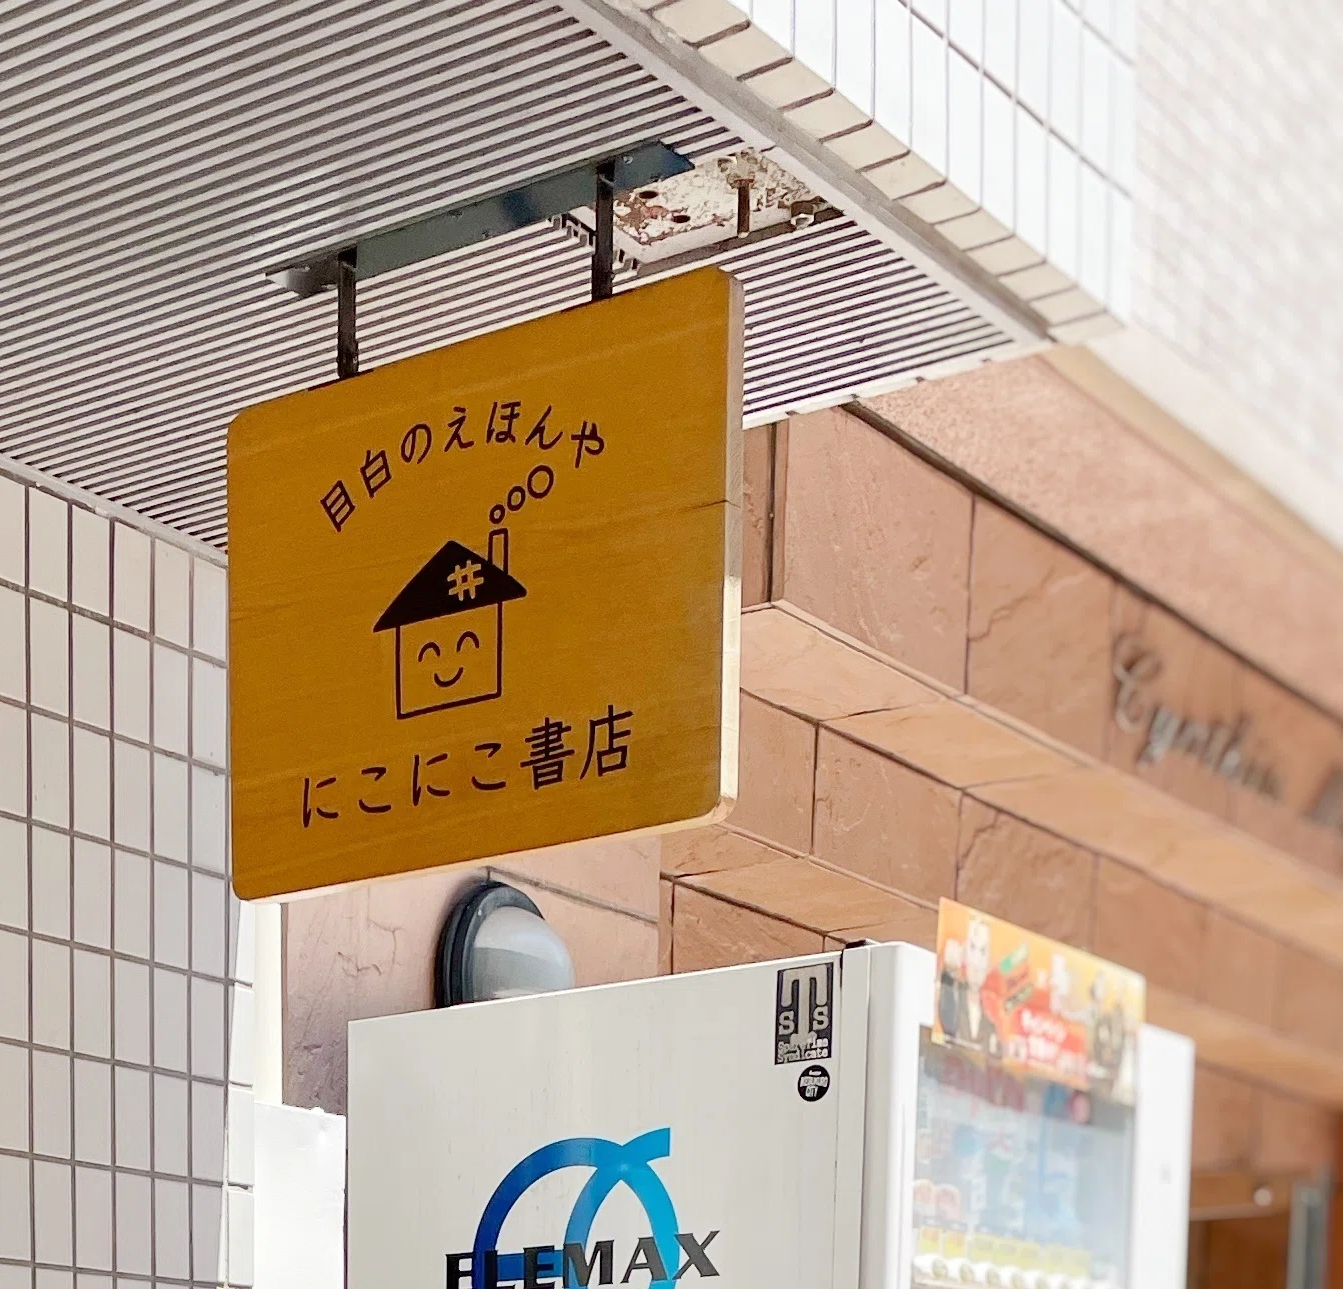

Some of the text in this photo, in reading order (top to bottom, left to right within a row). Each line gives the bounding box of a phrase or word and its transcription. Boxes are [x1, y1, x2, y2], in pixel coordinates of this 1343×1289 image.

[320, 401, 605, 532] 目白のえほんや
[302, 705, 634, 827] にこにこ書店
